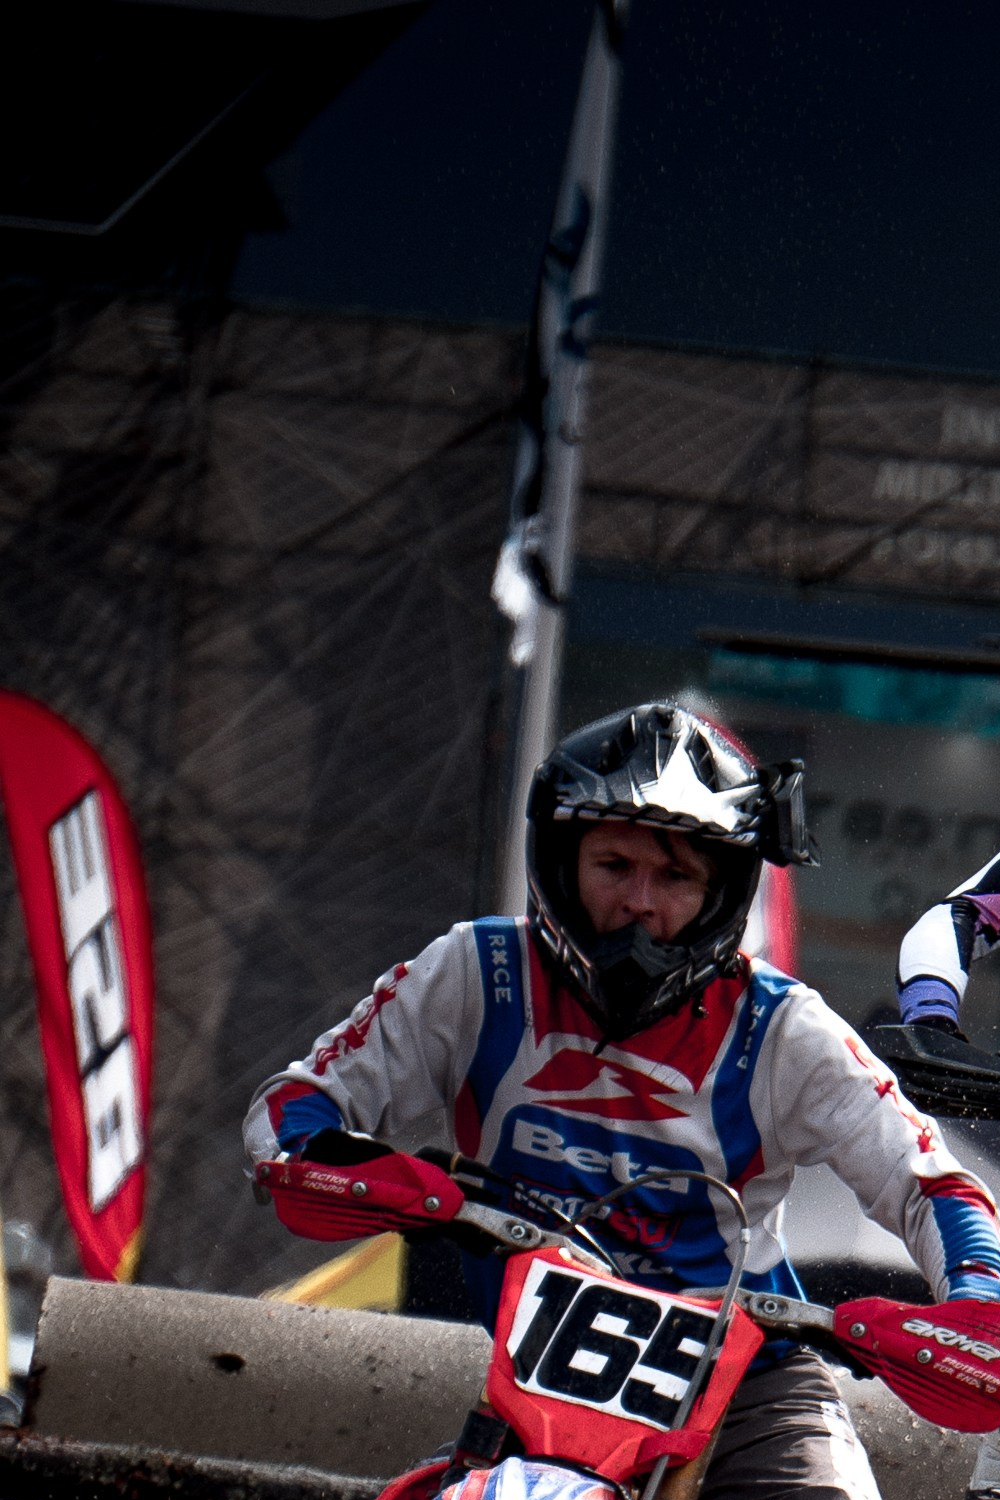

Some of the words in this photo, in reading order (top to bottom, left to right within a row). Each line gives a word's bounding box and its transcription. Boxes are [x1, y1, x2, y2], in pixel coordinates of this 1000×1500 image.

[511, 1118, 690, 1194] Beta
[511, 1269, 727, 1429] 165
[955, 1371, 998, 1394] ENDO
